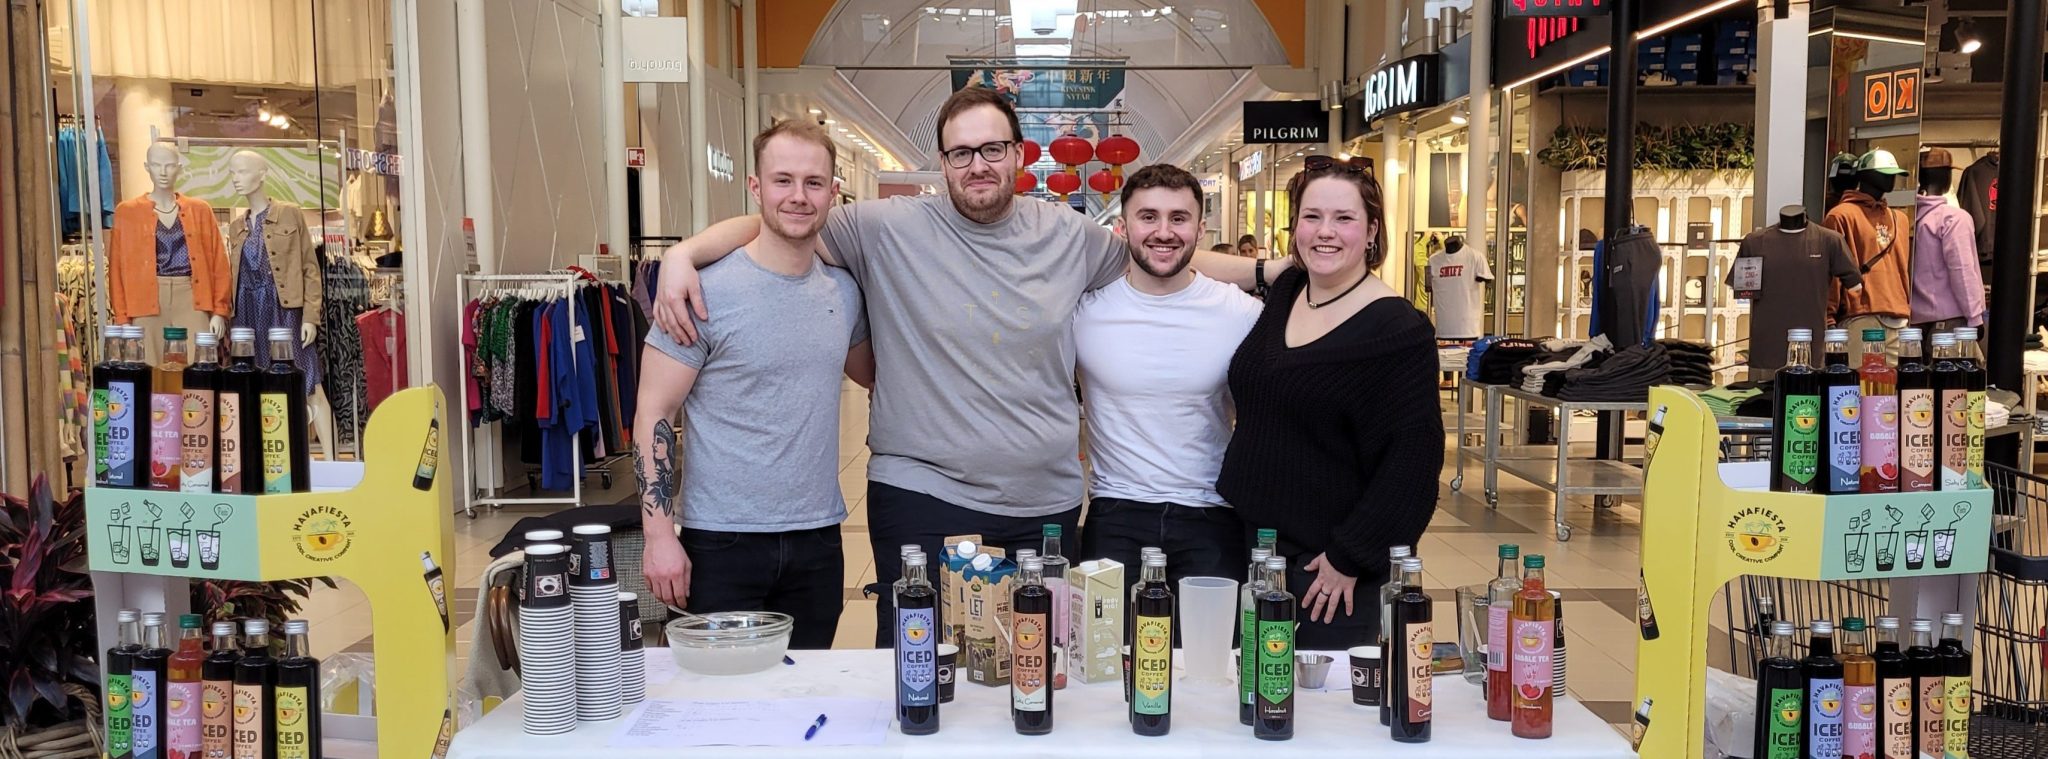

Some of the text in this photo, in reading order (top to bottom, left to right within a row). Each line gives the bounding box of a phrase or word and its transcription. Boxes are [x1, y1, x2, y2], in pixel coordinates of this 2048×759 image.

[1253, 127, 1319, 139] PILGRIM
[293, 506, 351, 531] HAVAFIESTA
[1728, 507, 1786, 532] HAVAFIESTA
[305, 554, 334, 562] CREATIVE
[1736, 552, 1763, 564] CREATIVE
[970, 599, 984, 617] LET
[902, 613, 931, 626] HAVAFIESTA
[1138, 621, 1168, 634] HAVAFIESTA
[903, 651, 932, 663] ICED
[1015, 654, 1042, 667] ICED
[1138, 658, 1167, 671] ICED
[1261, 663, 1291, 676] ICED
[908, 693, 929, 702] Natural
[1142, 701, 1161, 709] Vanilla
